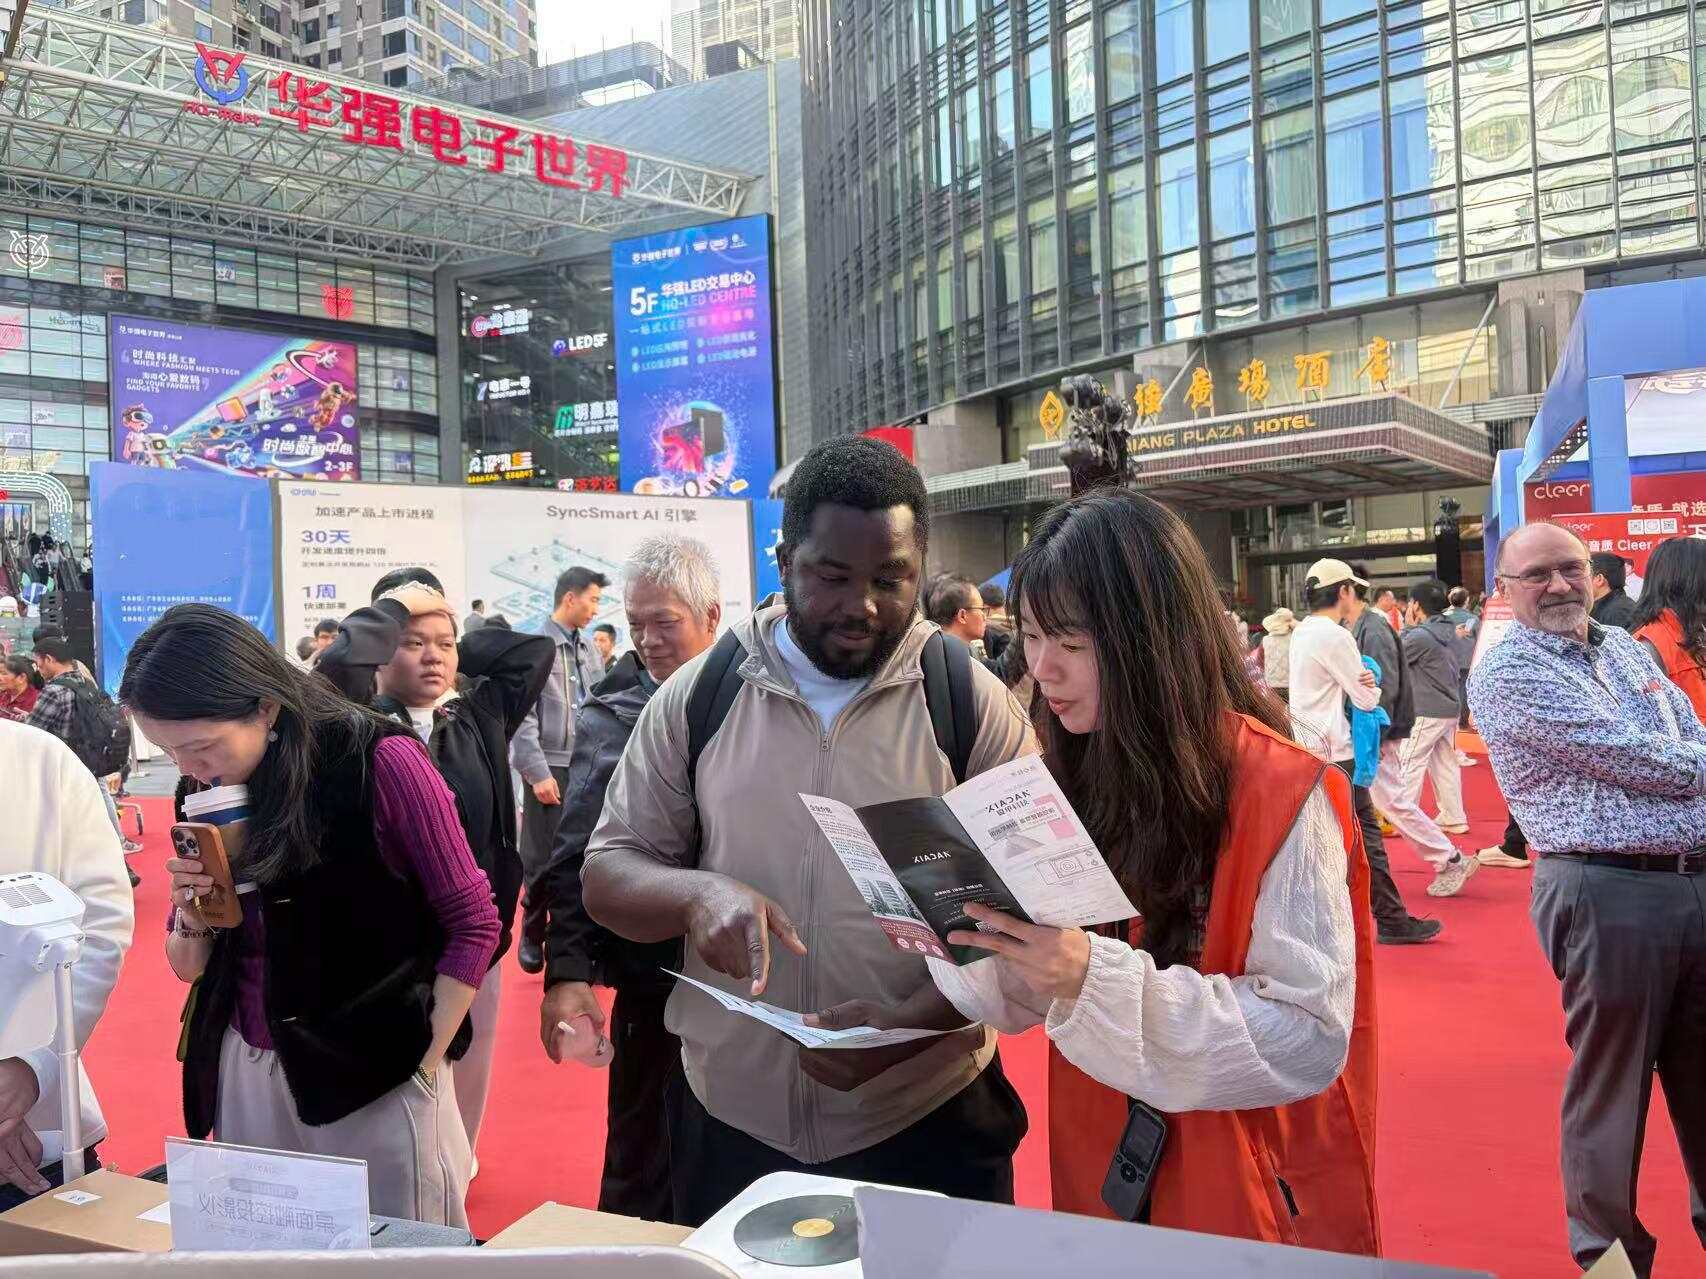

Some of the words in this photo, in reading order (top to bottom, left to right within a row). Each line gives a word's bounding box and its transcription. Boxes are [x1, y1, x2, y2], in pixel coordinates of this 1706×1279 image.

[269, 70, 630, 198] 华强电子世界
[630, 286, 658, 316] 5F
[133, 358, 159, 368] WHERE
[1183, 425, 1244, 444] PLAZA
[1253, 413, 1315, 434] HOTEL
[325, 461, 354, 472] 2-3F
[1534, 483, 1590, 499] cleer
[315, 506, 435, 519] 加速产品上市进程
[546, 506, 638, 520] SyncSmart
[643, 510, 659, 521] AI
[664, 509, 698, 522] 引擎
[301, 529, 350, 544] 30天
[1617, 540, 1652, 552] Cleer
[302, 584, 336, 599] 1周
